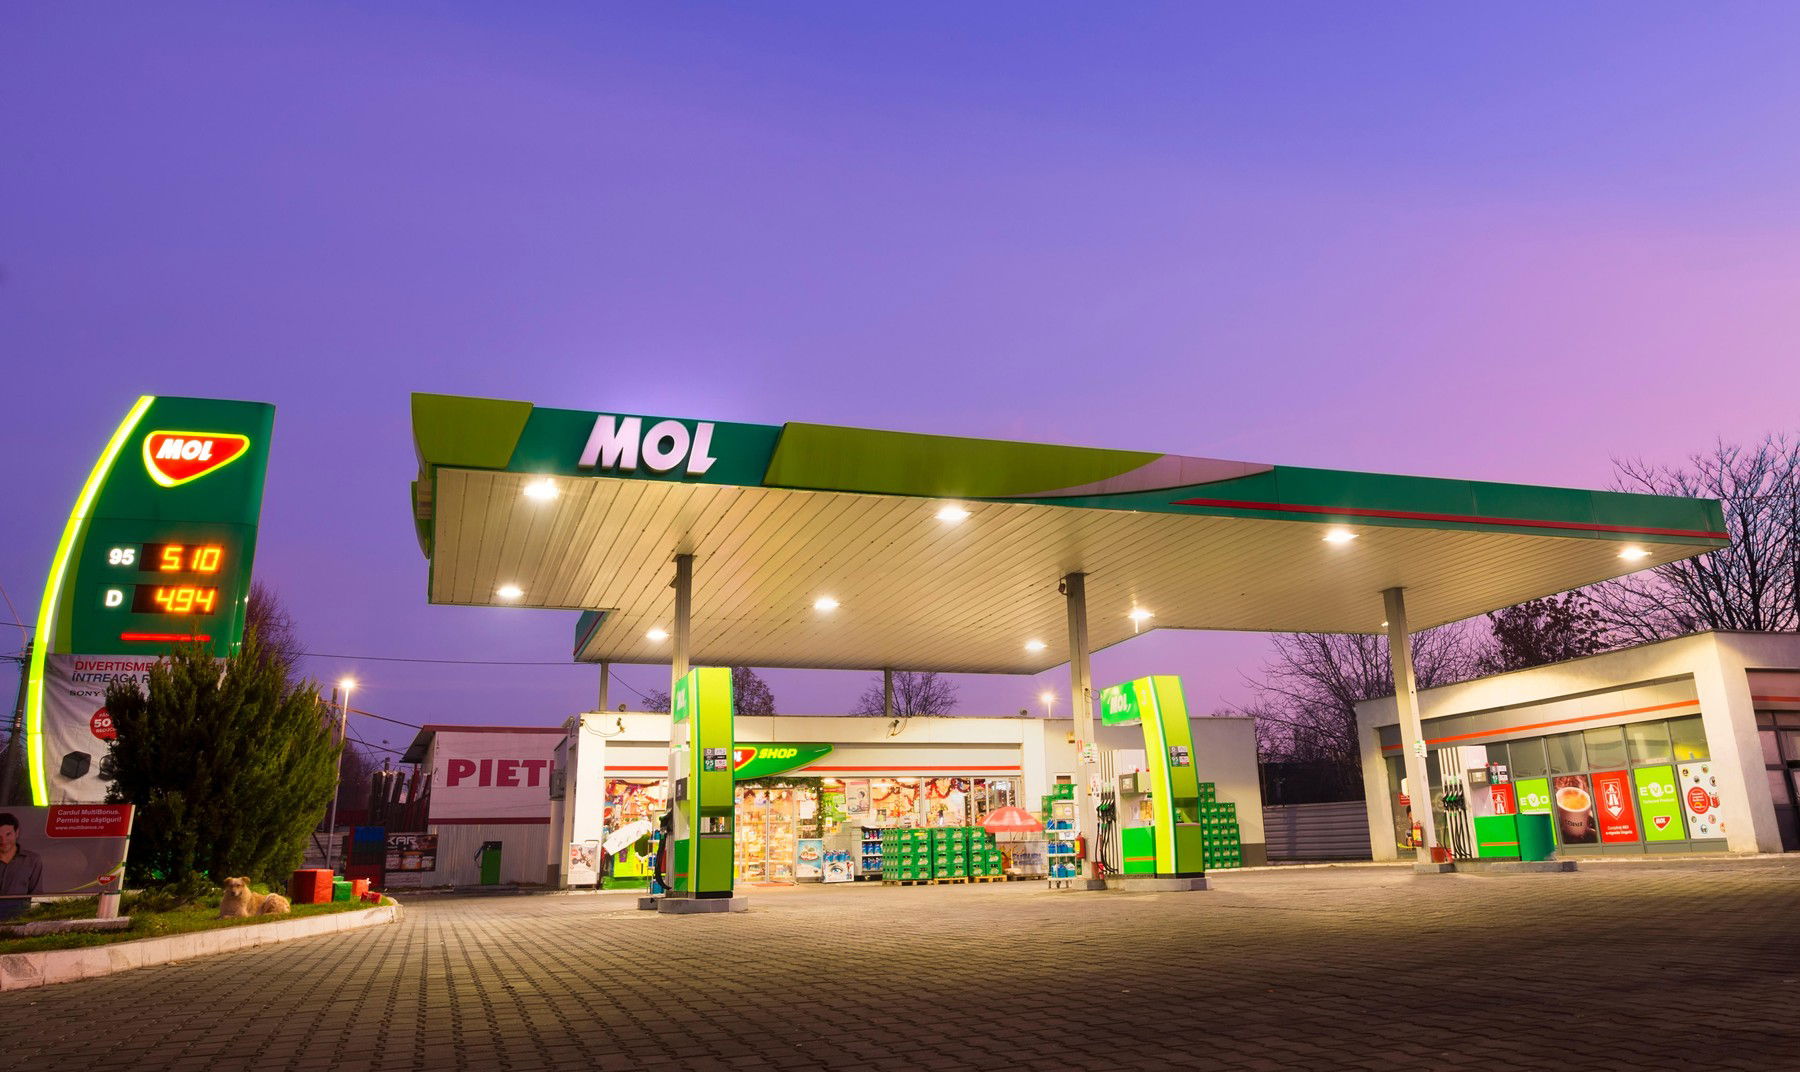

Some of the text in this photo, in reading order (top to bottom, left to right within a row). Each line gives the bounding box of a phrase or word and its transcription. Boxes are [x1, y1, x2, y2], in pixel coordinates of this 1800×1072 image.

[156, 438, 214, 461] MOL
[578, 414, 718, 475] MOL
[108, 548, 135, 566] 95
[105, 587, 216, 613] D 494
[94, 719, 111, 728] 50
[758, 748, 797, 759] SHOP
